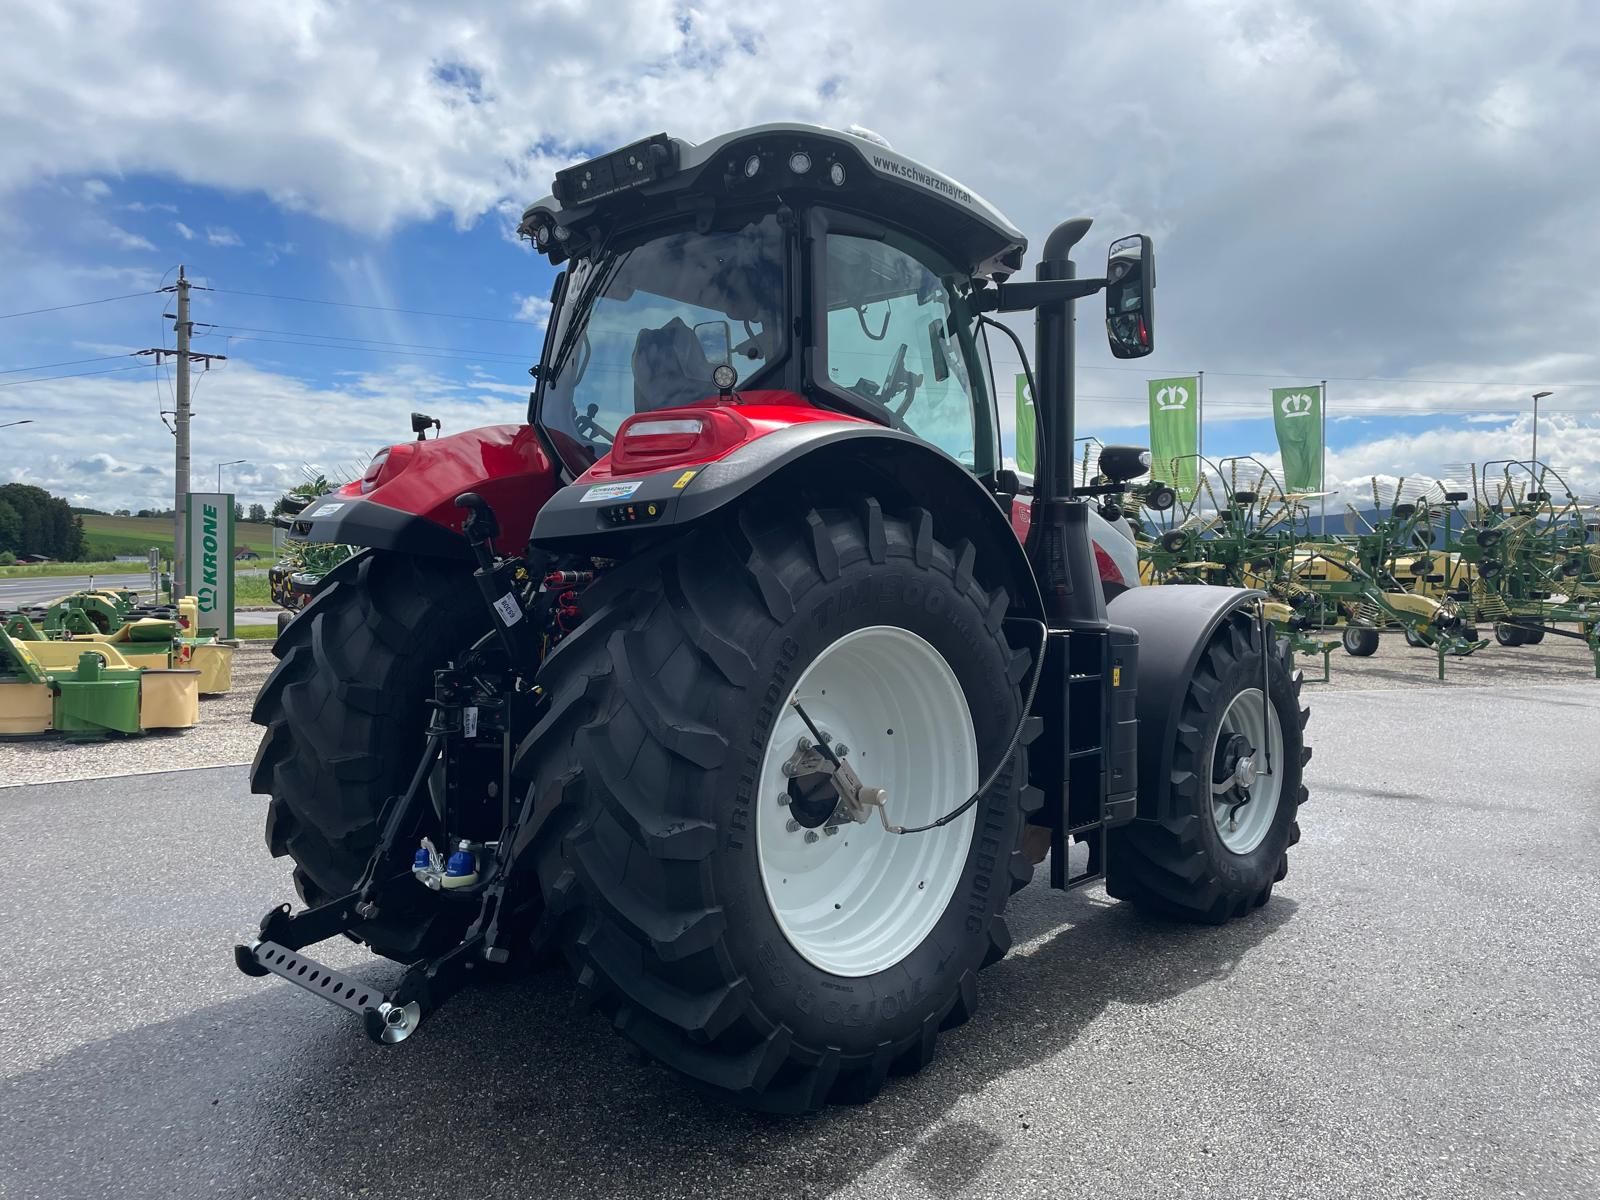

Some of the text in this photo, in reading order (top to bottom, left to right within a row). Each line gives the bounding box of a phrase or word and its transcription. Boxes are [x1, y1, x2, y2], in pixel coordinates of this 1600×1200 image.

[873, 155, 973, 204] www.schwarzmayr.at
[203, 503, 217, 586] KRONE
[727, 635, 800, 853] TRELLEBORG
